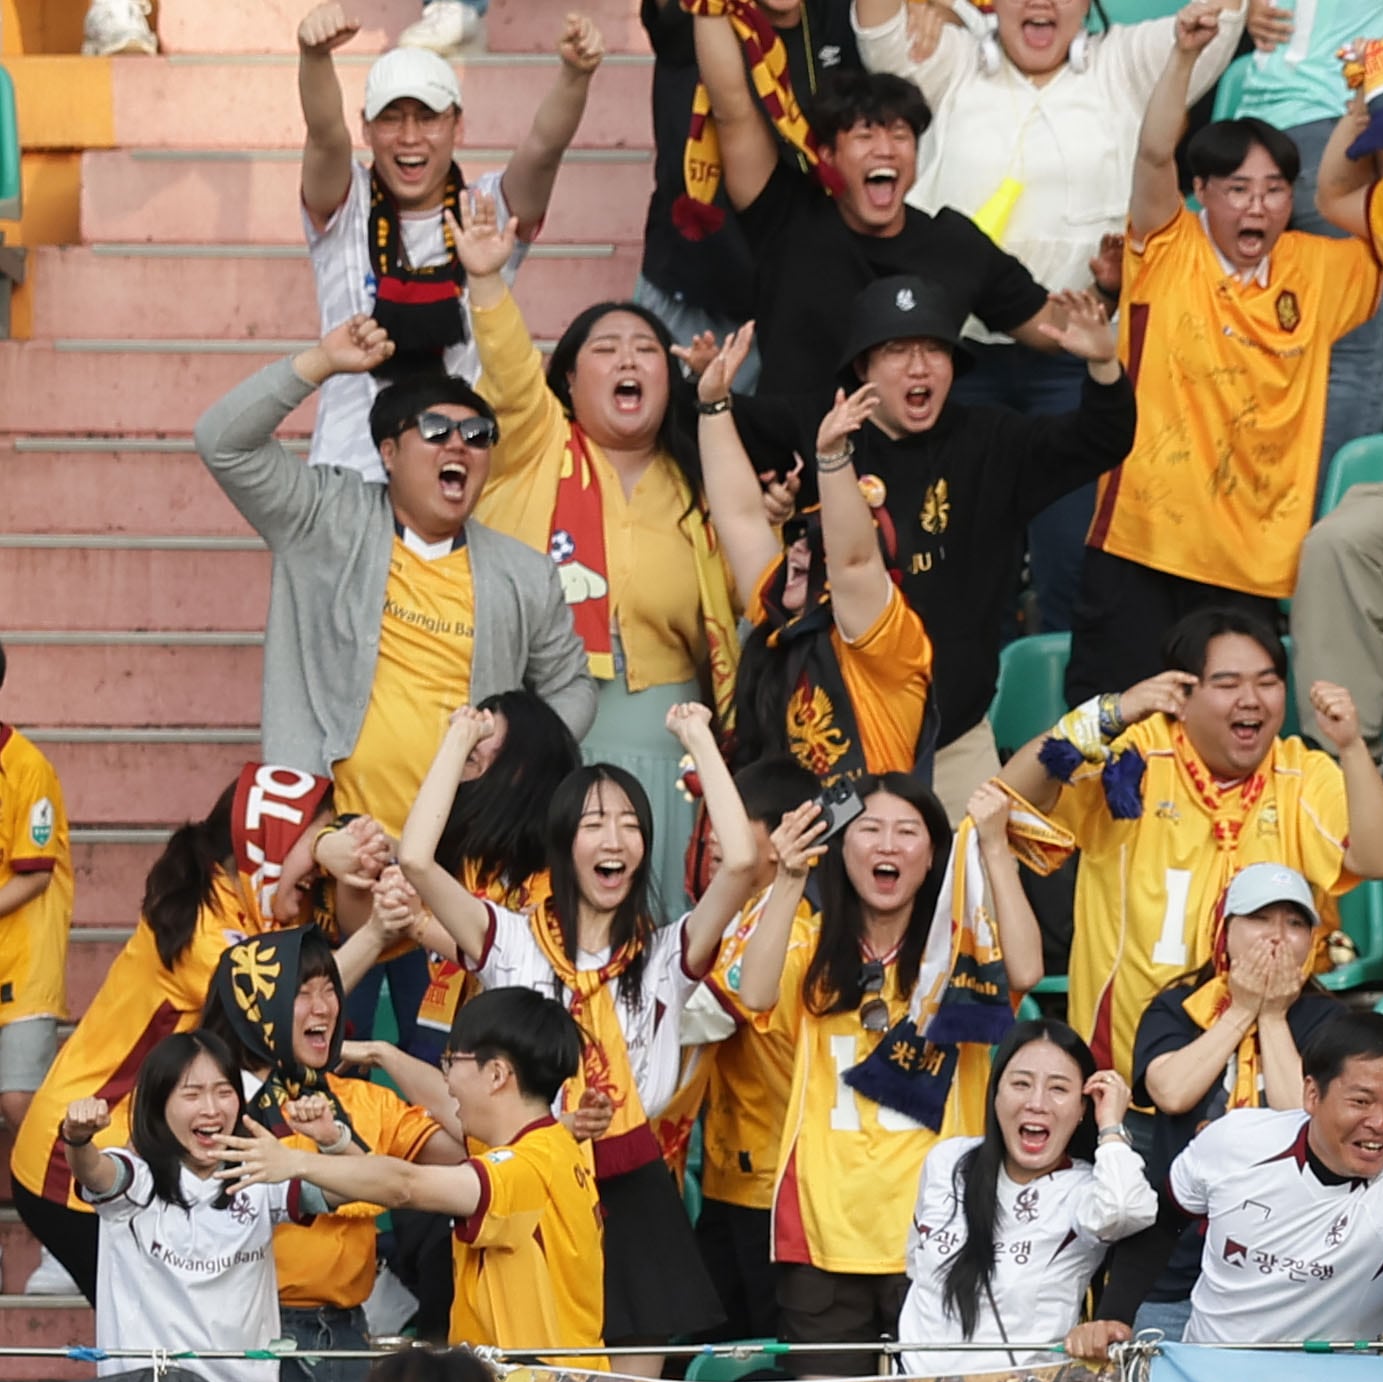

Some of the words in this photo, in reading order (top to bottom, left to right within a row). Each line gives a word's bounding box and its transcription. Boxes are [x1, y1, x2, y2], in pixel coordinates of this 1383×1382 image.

[383, 599, 450, 634] Kwangju
[453, 620, 475, 639] Ba
[162, 1247, 231, 1276] Kwangju
[232, 1246, 265, 1266] Bank
[933, 1229, 1033, 1267] 광은행
